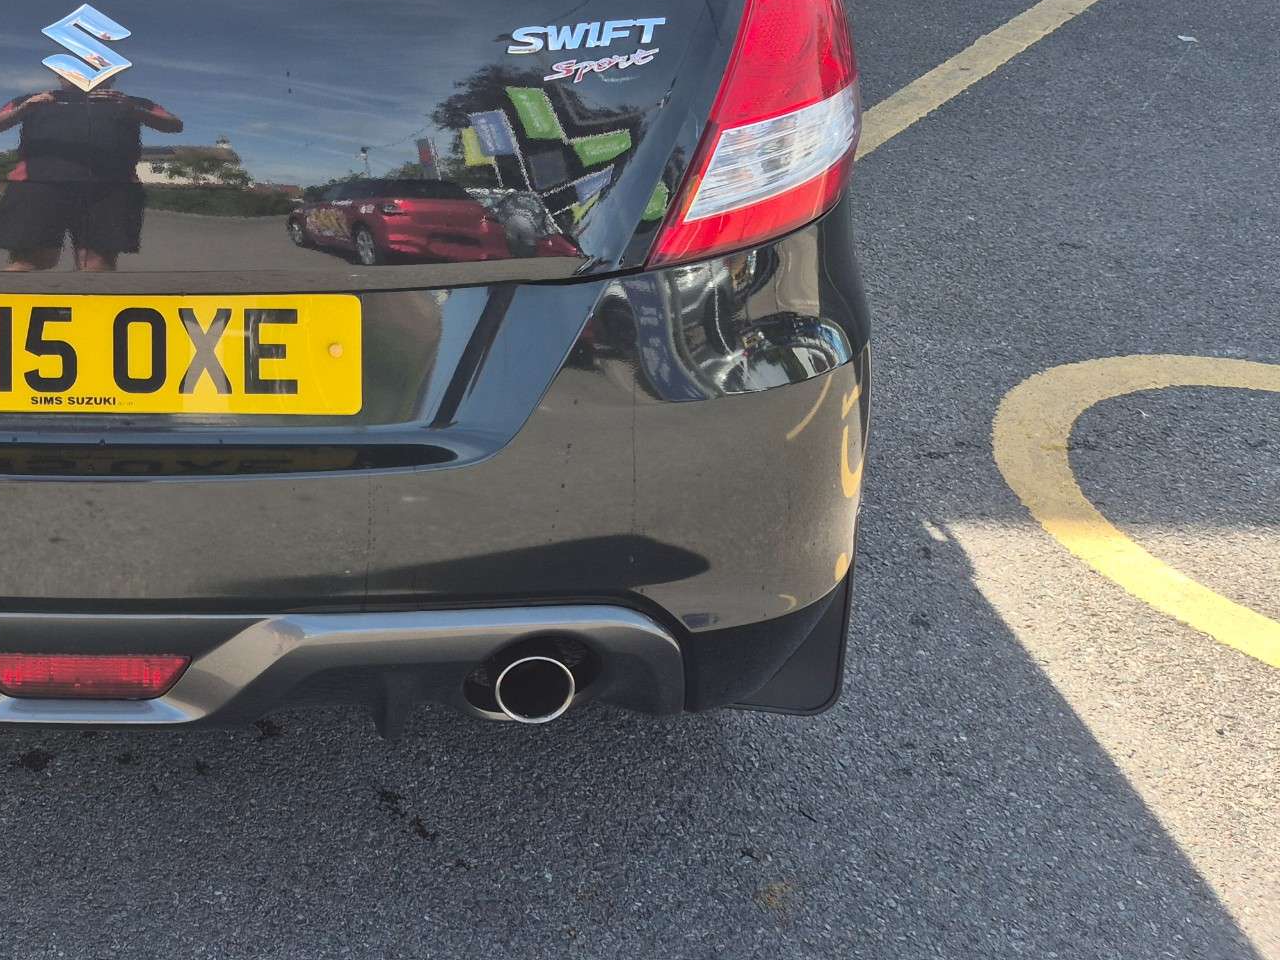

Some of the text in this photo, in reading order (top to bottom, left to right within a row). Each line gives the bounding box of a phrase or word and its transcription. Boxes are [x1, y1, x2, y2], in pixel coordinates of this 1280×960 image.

[507, 17, 666, 54] SWIFT
[544, 48, 659, 83] Sport
[112, 307, 298, 394] OXE
[31, 396, 63, 406] SIMS
[67, 396, 116, 406] SUZUKI
